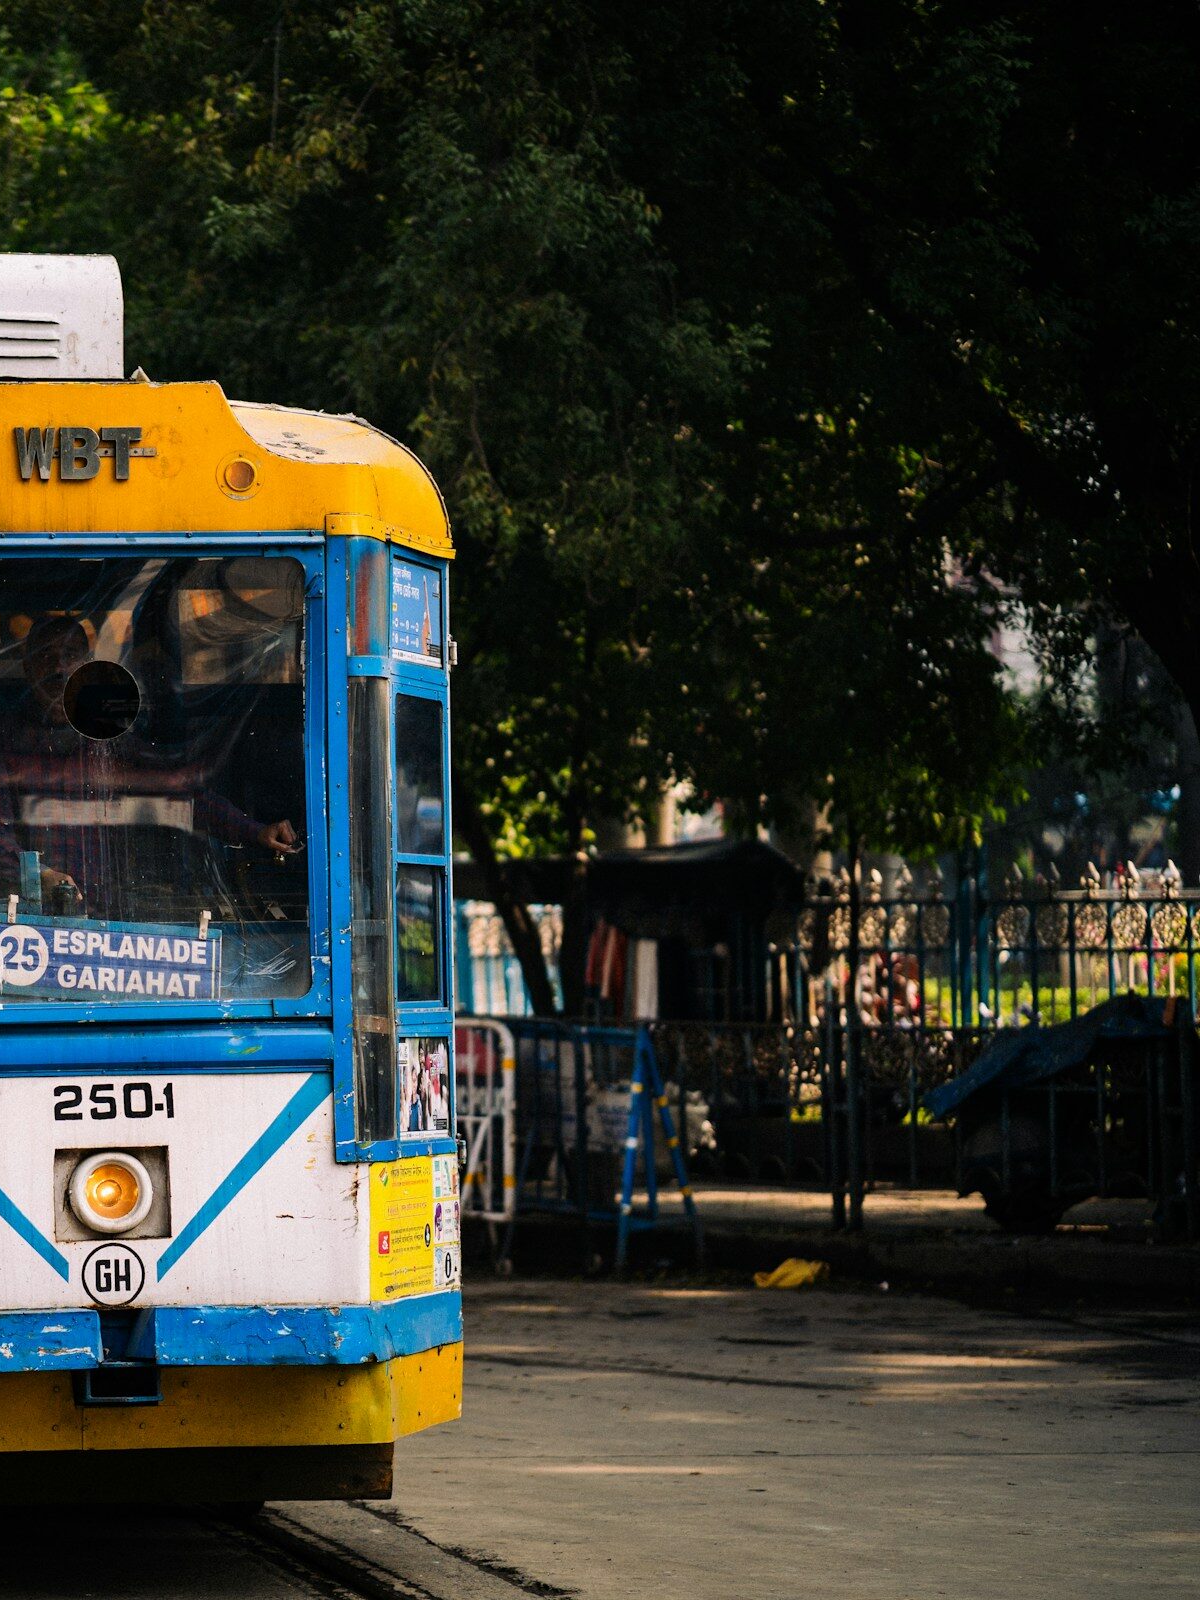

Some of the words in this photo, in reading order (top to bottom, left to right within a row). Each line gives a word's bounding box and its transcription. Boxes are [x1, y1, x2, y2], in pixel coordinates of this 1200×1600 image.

[13, 426, 143, 480] WBT
[0, 936, 40, 971] 25
[53, 930, 207, 965] ESPLANADE
[57, 964, 201, 998] GARIAHAT
[96, 1259, 131, 1292] GH
